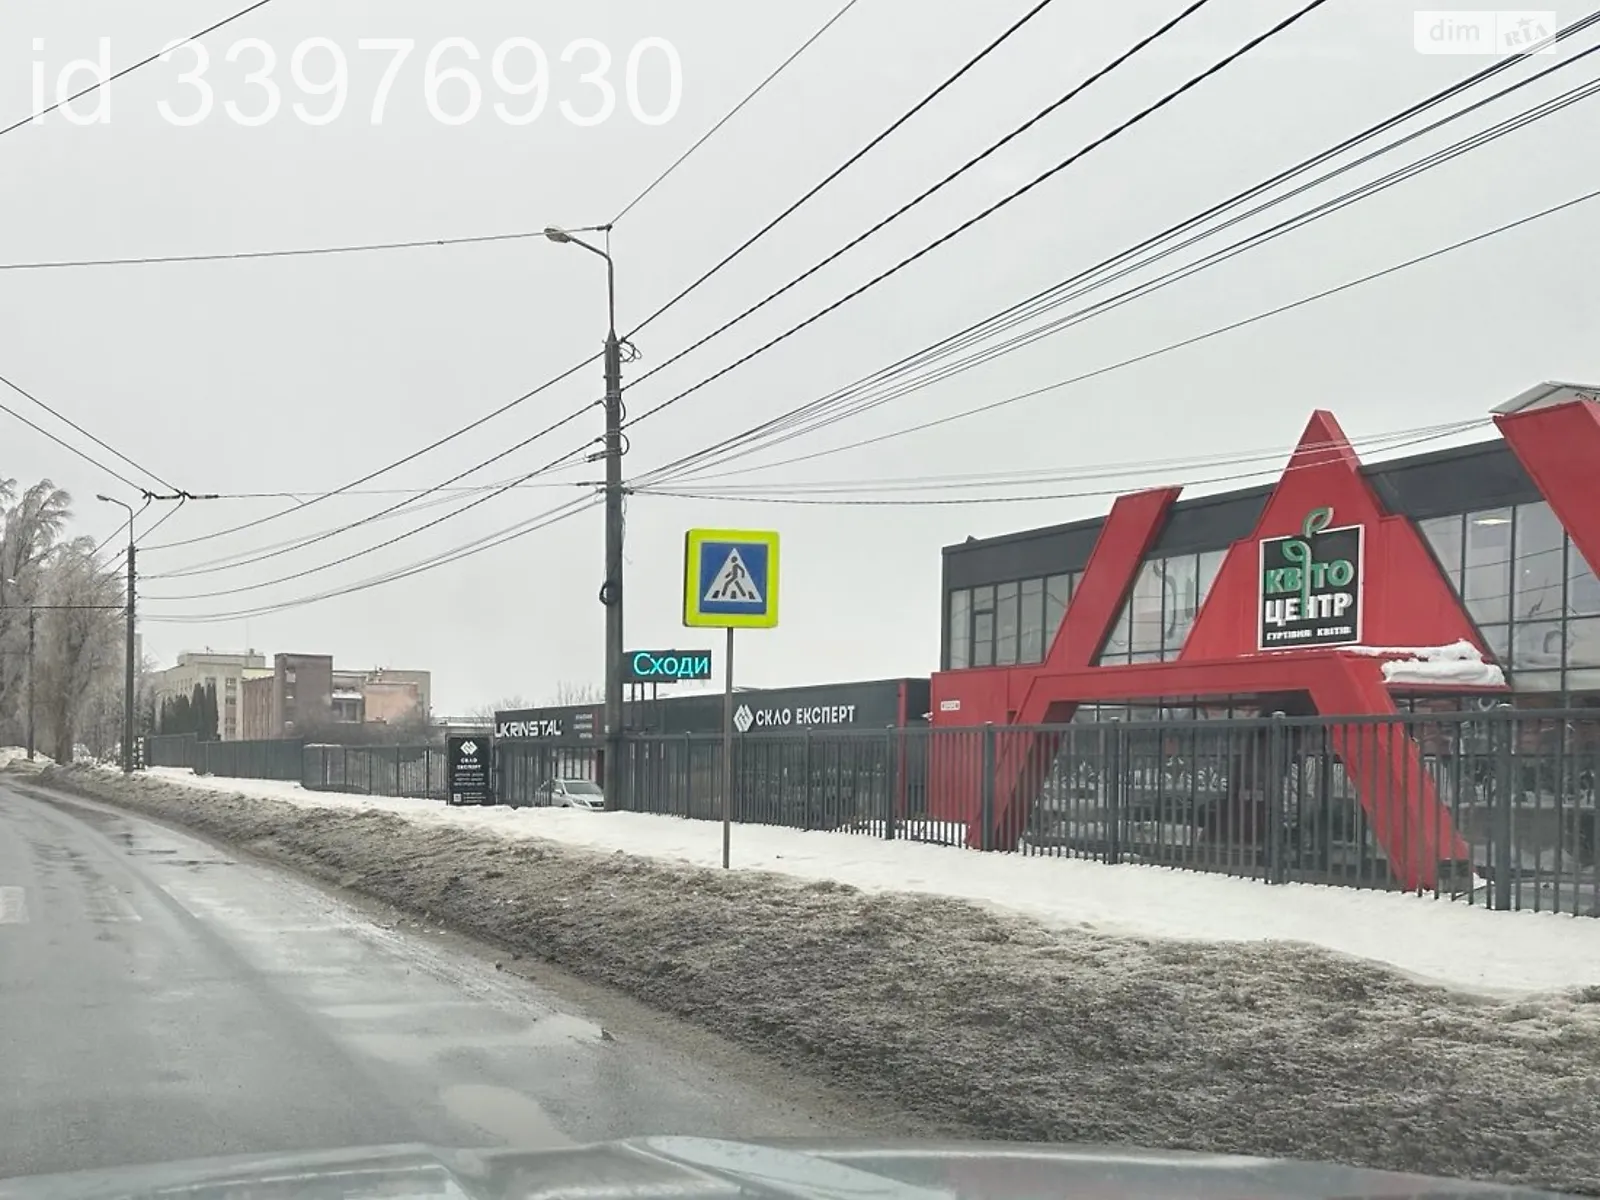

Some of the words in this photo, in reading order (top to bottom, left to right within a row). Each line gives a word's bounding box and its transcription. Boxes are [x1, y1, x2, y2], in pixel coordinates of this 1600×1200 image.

[1264, 593, 1354, 626] ЦЕНТР
[633, 651, 709, 678] Сходи
[755, 708, 792, 727] СКЛО
[796, 704, 856, 725] ЕКСПЕРТ
